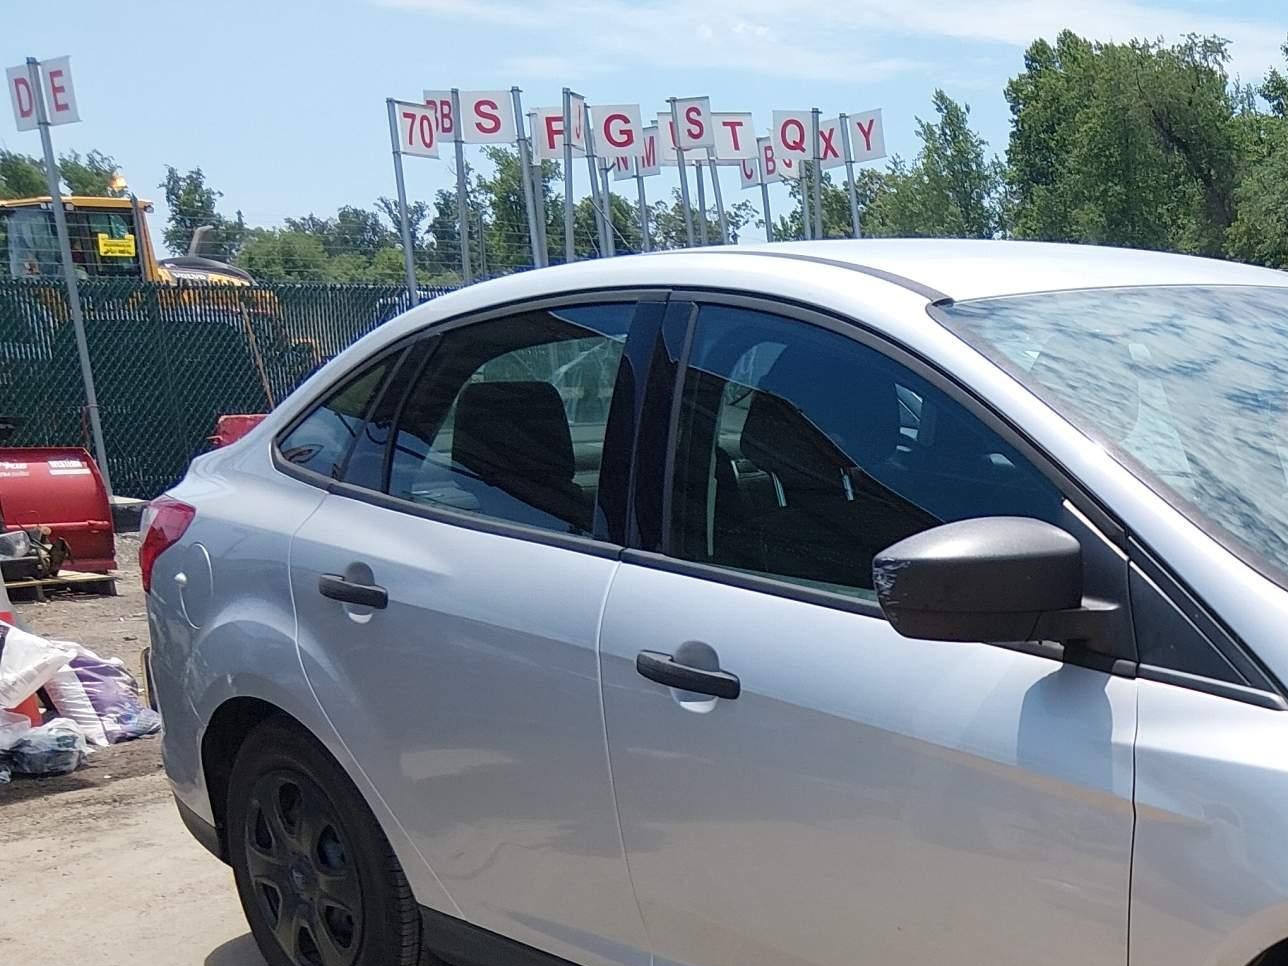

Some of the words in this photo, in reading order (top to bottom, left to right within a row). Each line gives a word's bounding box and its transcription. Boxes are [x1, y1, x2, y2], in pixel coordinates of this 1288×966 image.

[14, 77, 33, 118] D
[49, 70, 70, 112] E
[403, 111, 434, 149] 70
[474, 99, 501, 134] S
[545, 116, 564, 149] F
[603, 113, 634, 148] G
[685, 106, 704, 140] S
[722, 121, 743, 151] T
[781, 119, 806, 152] Q
[820, 127, 839, 160] X
[857, 119, 874, 151] Y
[764, 145, 776, 176] B
